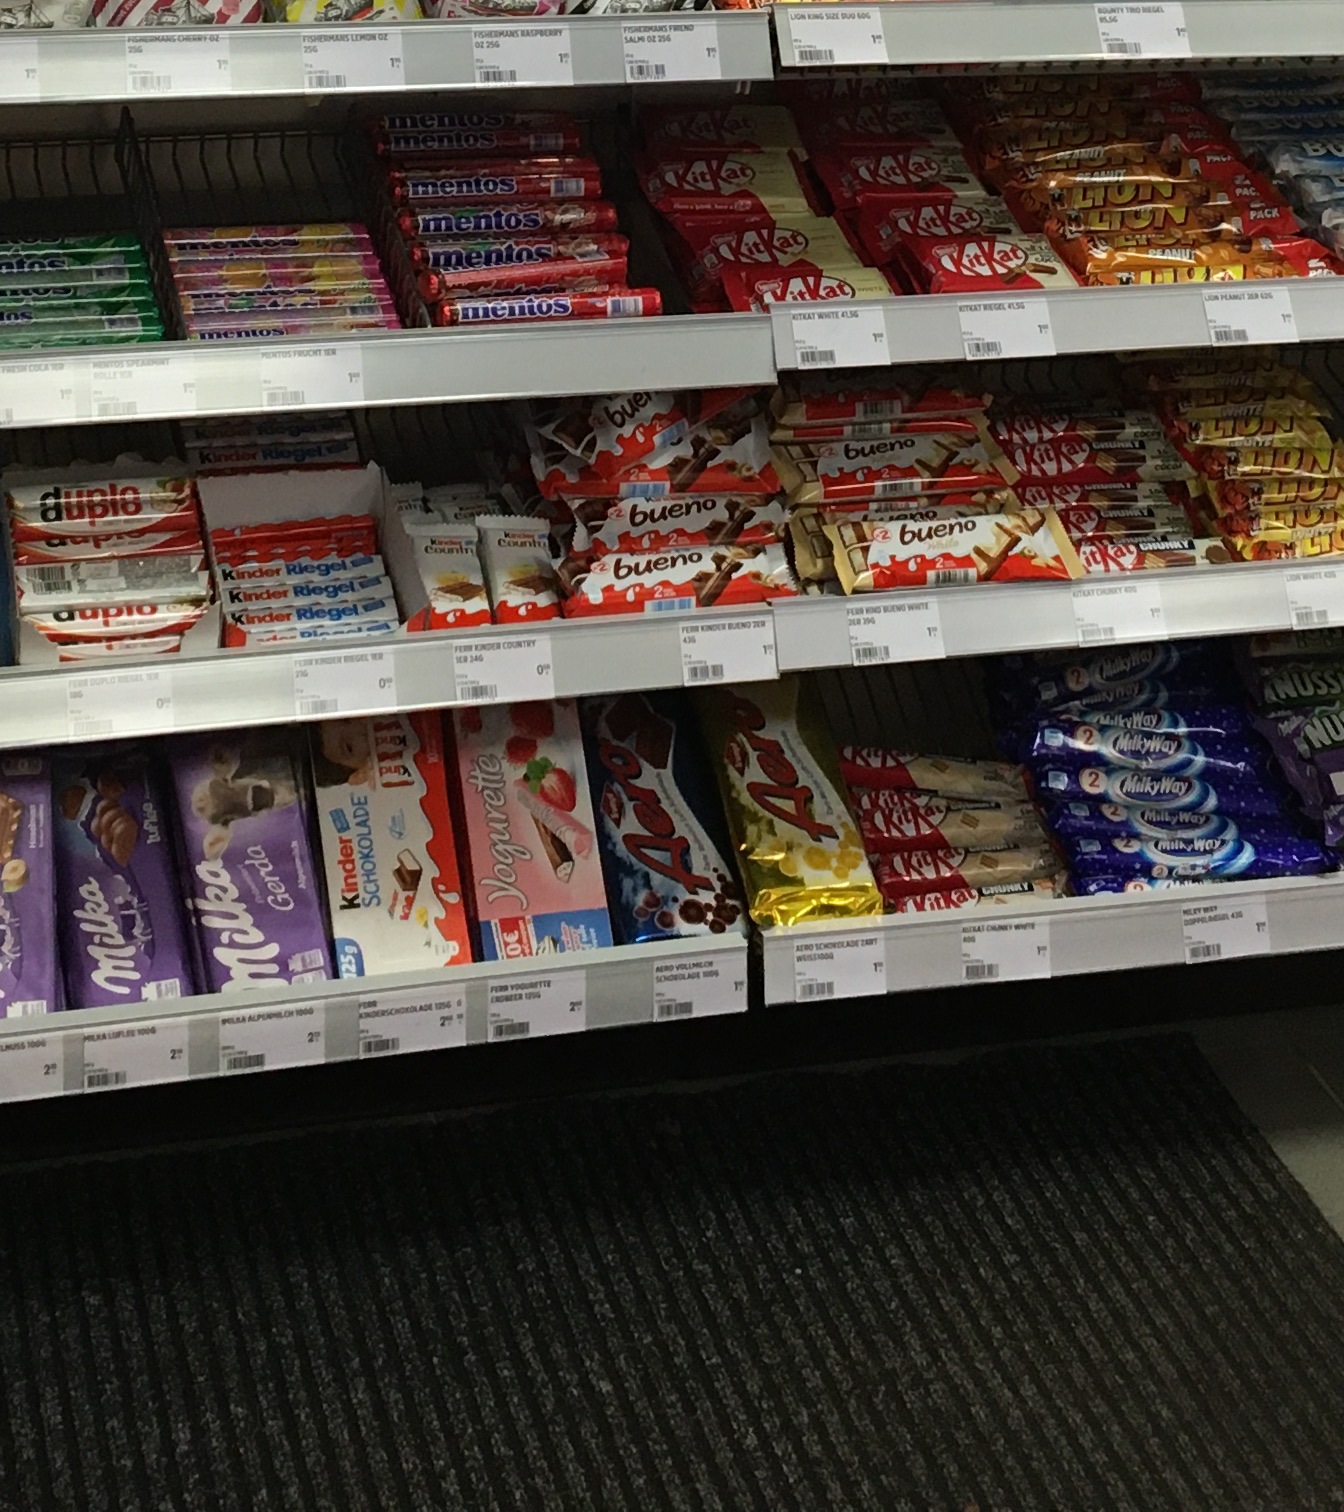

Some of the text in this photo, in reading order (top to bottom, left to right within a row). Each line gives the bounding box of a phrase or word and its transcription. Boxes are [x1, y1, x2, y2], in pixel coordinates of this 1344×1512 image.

[410, 176, 516, 197] mentos
[459, 297, 571, 318] mentos
[629, 498, 716, 527] bueno
[613, 551, 702, 579] bueno
[475, 753, 533, 910] Yogurette
[361, 796, 381, 908] SCHOKOLADE
[73, 876, 131, 995] Milka
